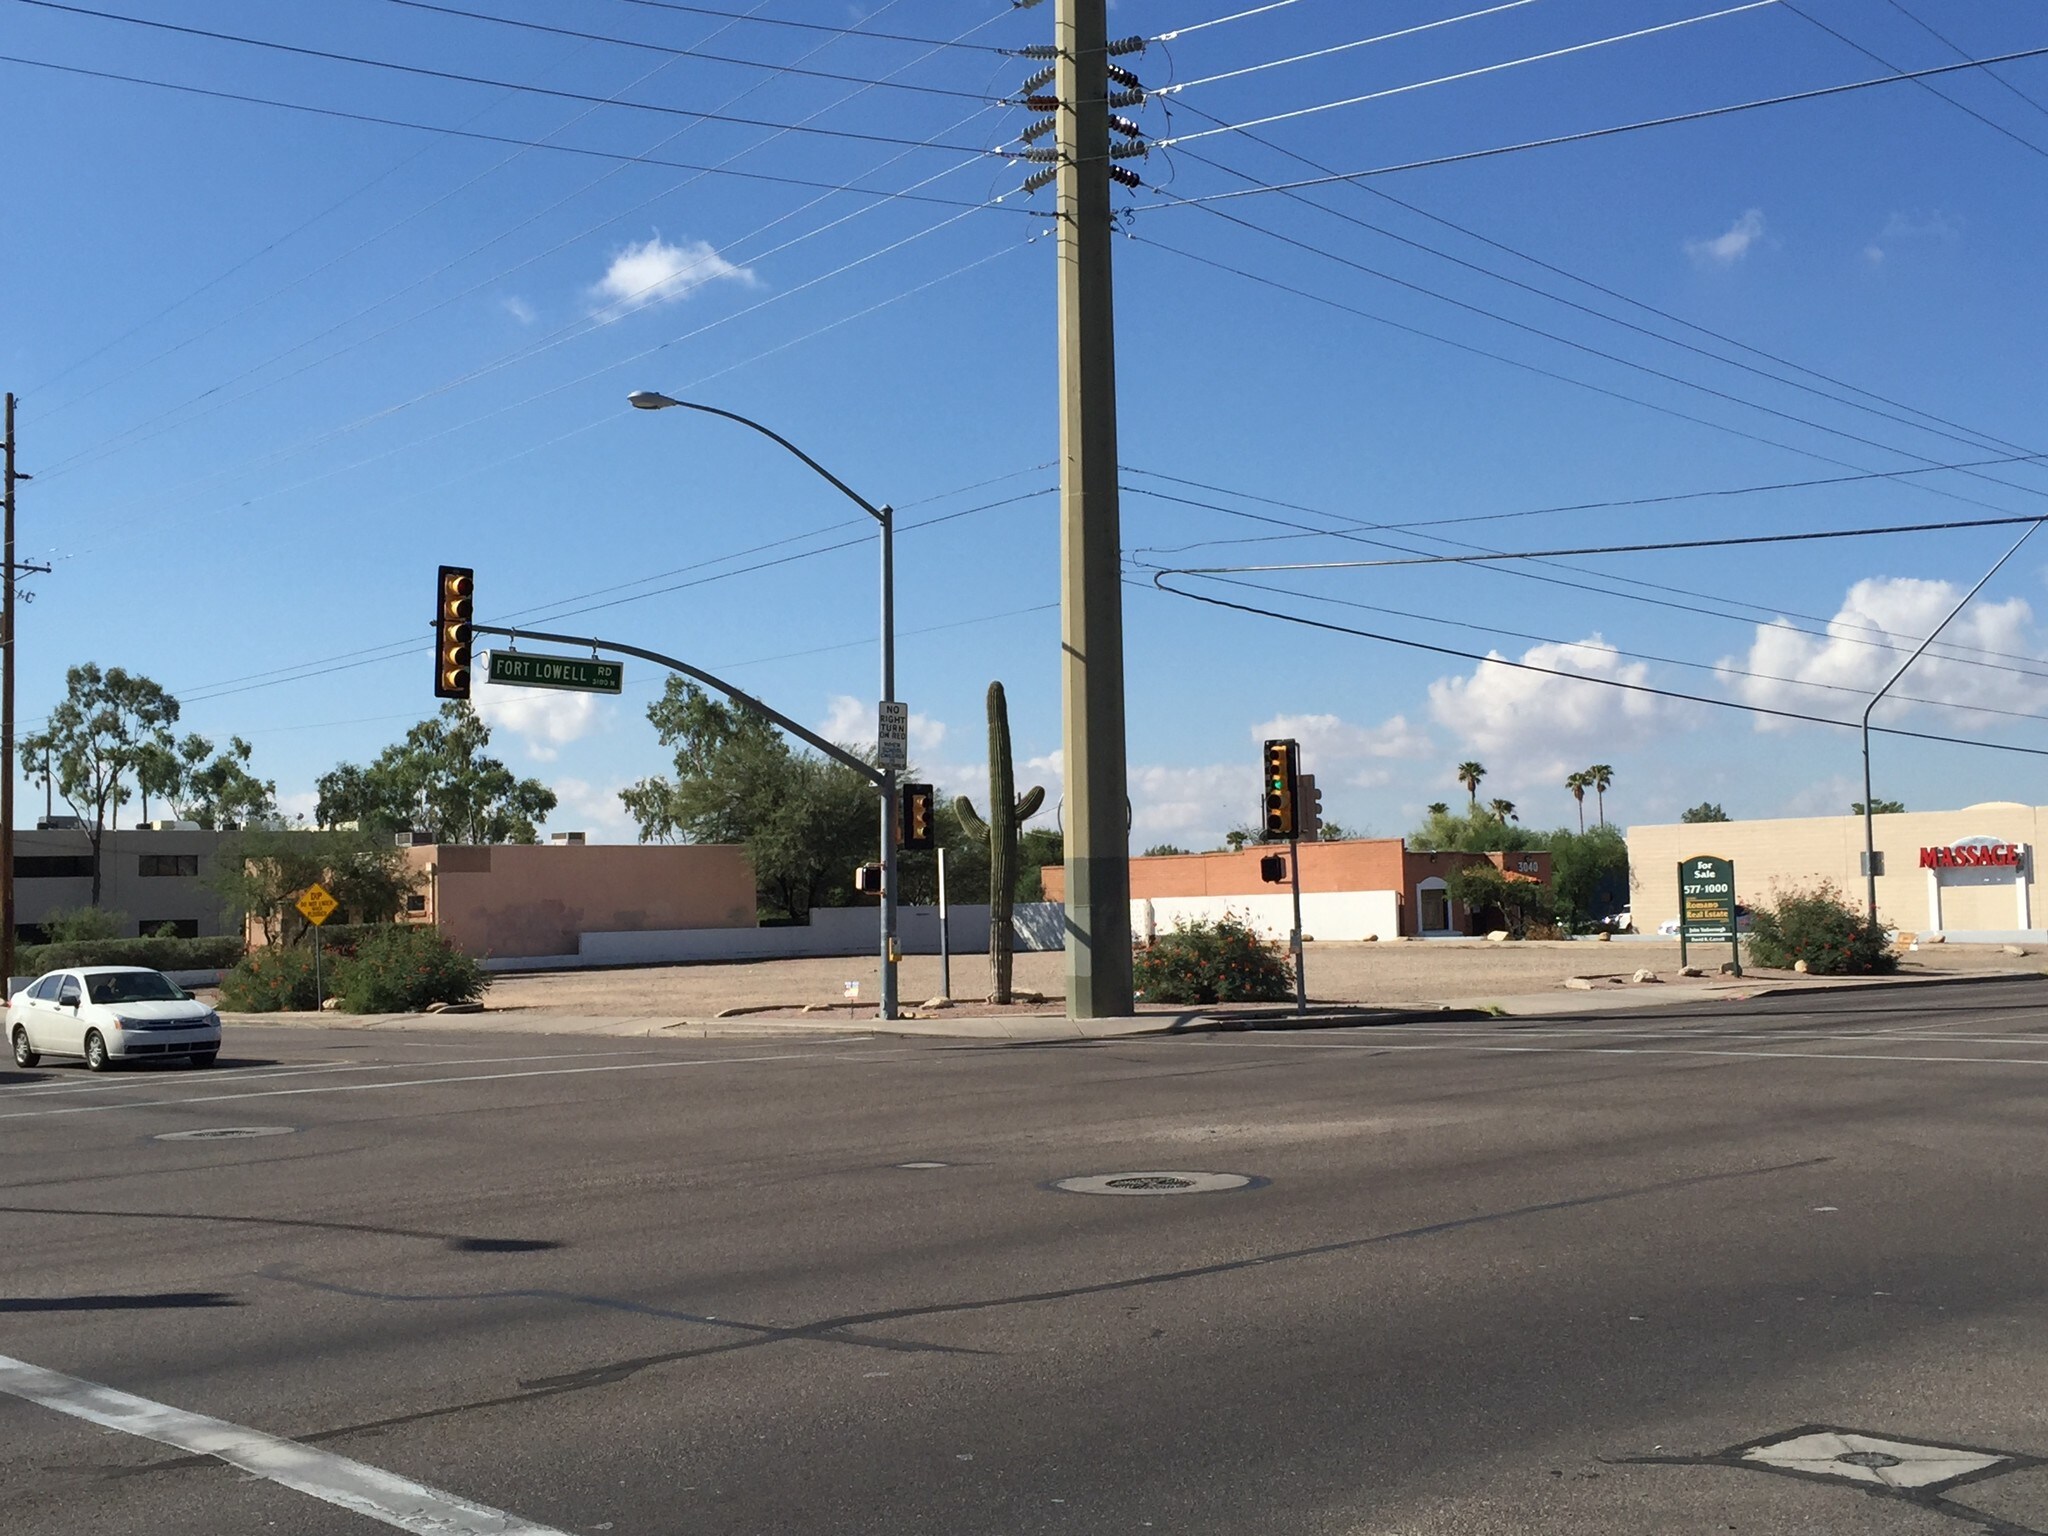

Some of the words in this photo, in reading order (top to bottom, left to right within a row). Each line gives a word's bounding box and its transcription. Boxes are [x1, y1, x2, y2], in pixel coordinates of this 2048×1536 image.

[496, 660, 530, 676] FORT
[535, 663, 587, 682] LOWELL
[597, 666, 613, 677] RD
[886, 705, 900, 714] NO
[880, 715, 905, 724] RIGHT
[881, 723, 905, 732] TURN
[880, 731, 889, 739] ON
[892, 732, 906, 740] RED
[1919, 844, 2019, 870] MASSAGE
[1517, 861, 1539, 873] 3040
[1697, 861, 1713, 870] For
[1694, 870, 1716, 879] Sale
[1683, 883, 1728, 894] 577-1000
[310, 892, 323, 901] DIP
[1686, 901, 1719, 909] Romano
[1686, 910, 1704, 918] Real
[1704, 910, 1729, 918] Estate
